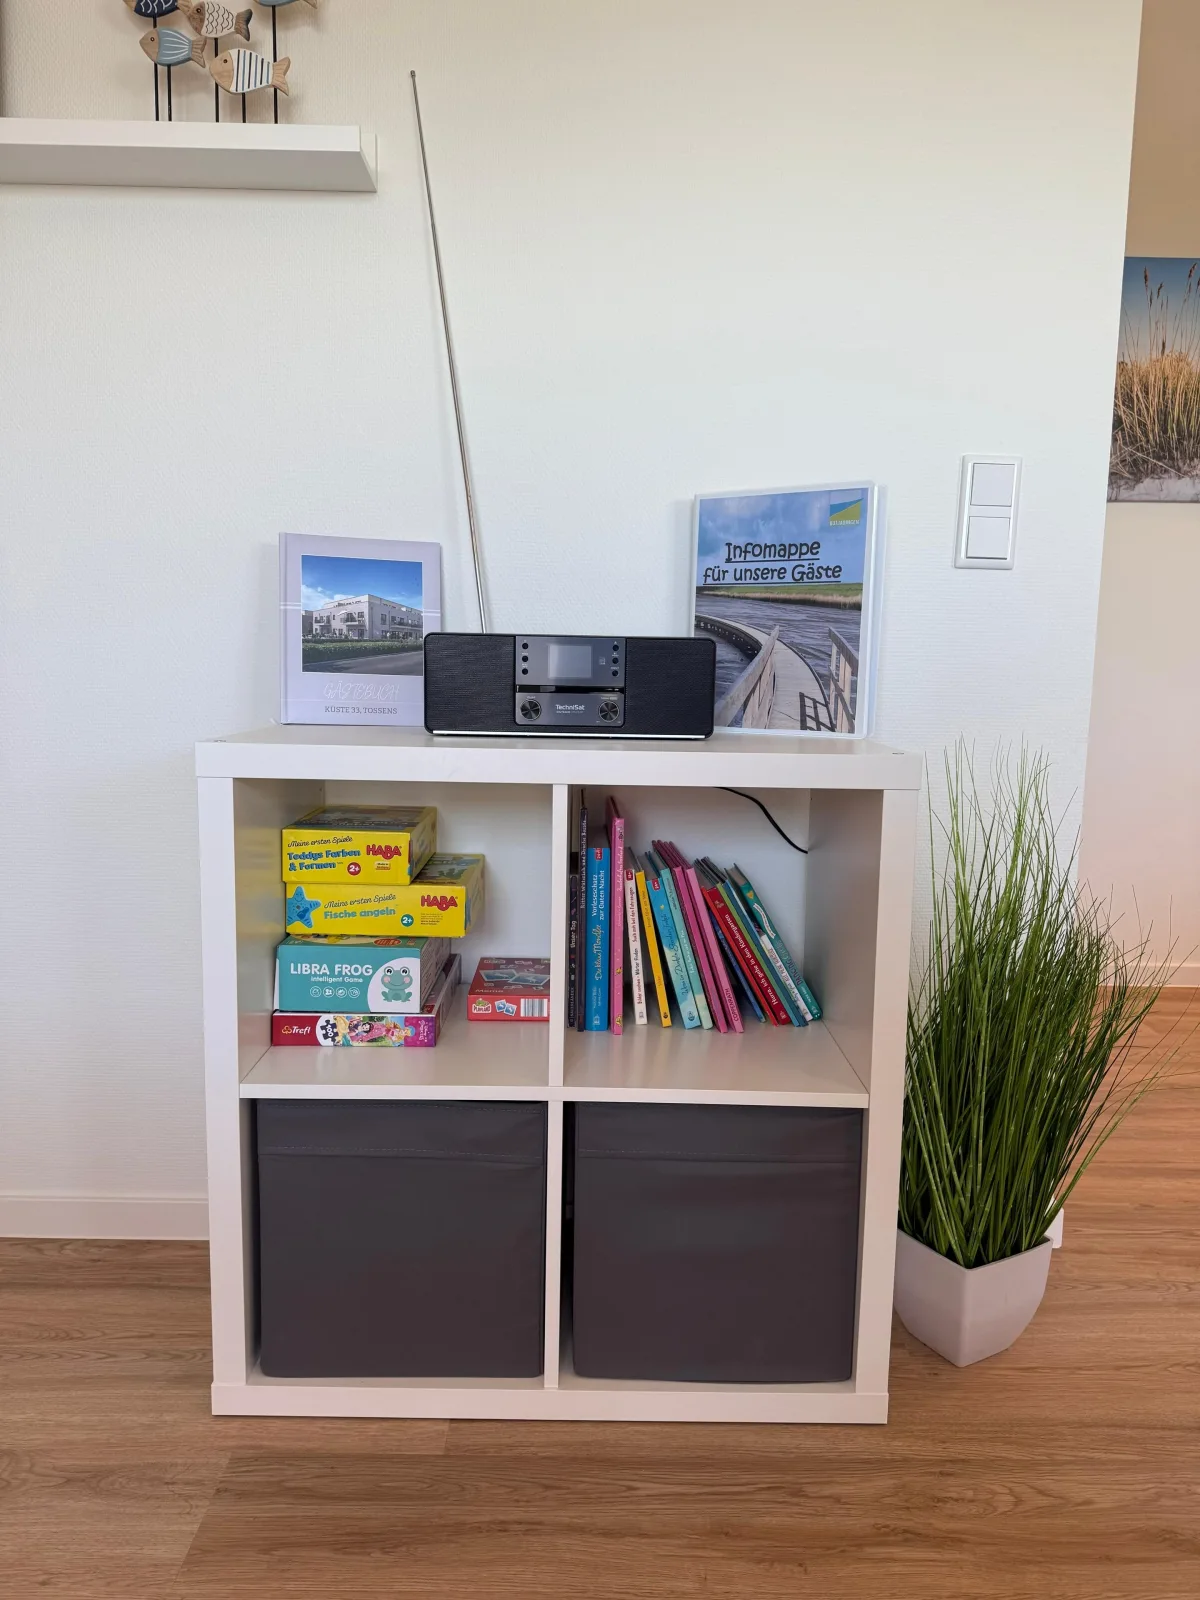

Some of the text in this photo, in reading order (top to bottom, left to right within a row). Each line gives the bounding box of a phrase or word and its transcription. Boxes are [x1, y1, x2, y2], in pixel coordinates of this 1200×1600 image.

[724, 540, 820, 560] Infomappe
[703, 562, 842, 583] für unsere Gäste
[323, 680, 400, 701] GÄSTEBUCH
[324, 705, 398, 715] KÜSTE 33, TOSSENS
[288, 835, 353, 848] Meine ersten Spiele
[287, 849, 361, 860] Teddys Farben
[366, 844, 401, 860] HABA
[289, 862, 336, 871] & Formen
[349, 864, 361, 873] 2+
[324, 893, 396, 909] Meine ersten Spiele
[420, 895, 458, 911] HABA
[323, 907, 396, 920] Fische angeln
[402, 916, 413, 924] 2+
[724, 913, 747, 949] Kindergarten
[743, 948, 752, 959] den
[290, 962, 373, 976] LIBRA FROG
[753, 964, 764, 978] gehe
[759, 978, 768, 988] ich
[765, 986, 778, 1006] Hurra,
[724, 988, 739, 1022] COPPENRATH
[291, 1025, 310, 1035] Trefl
